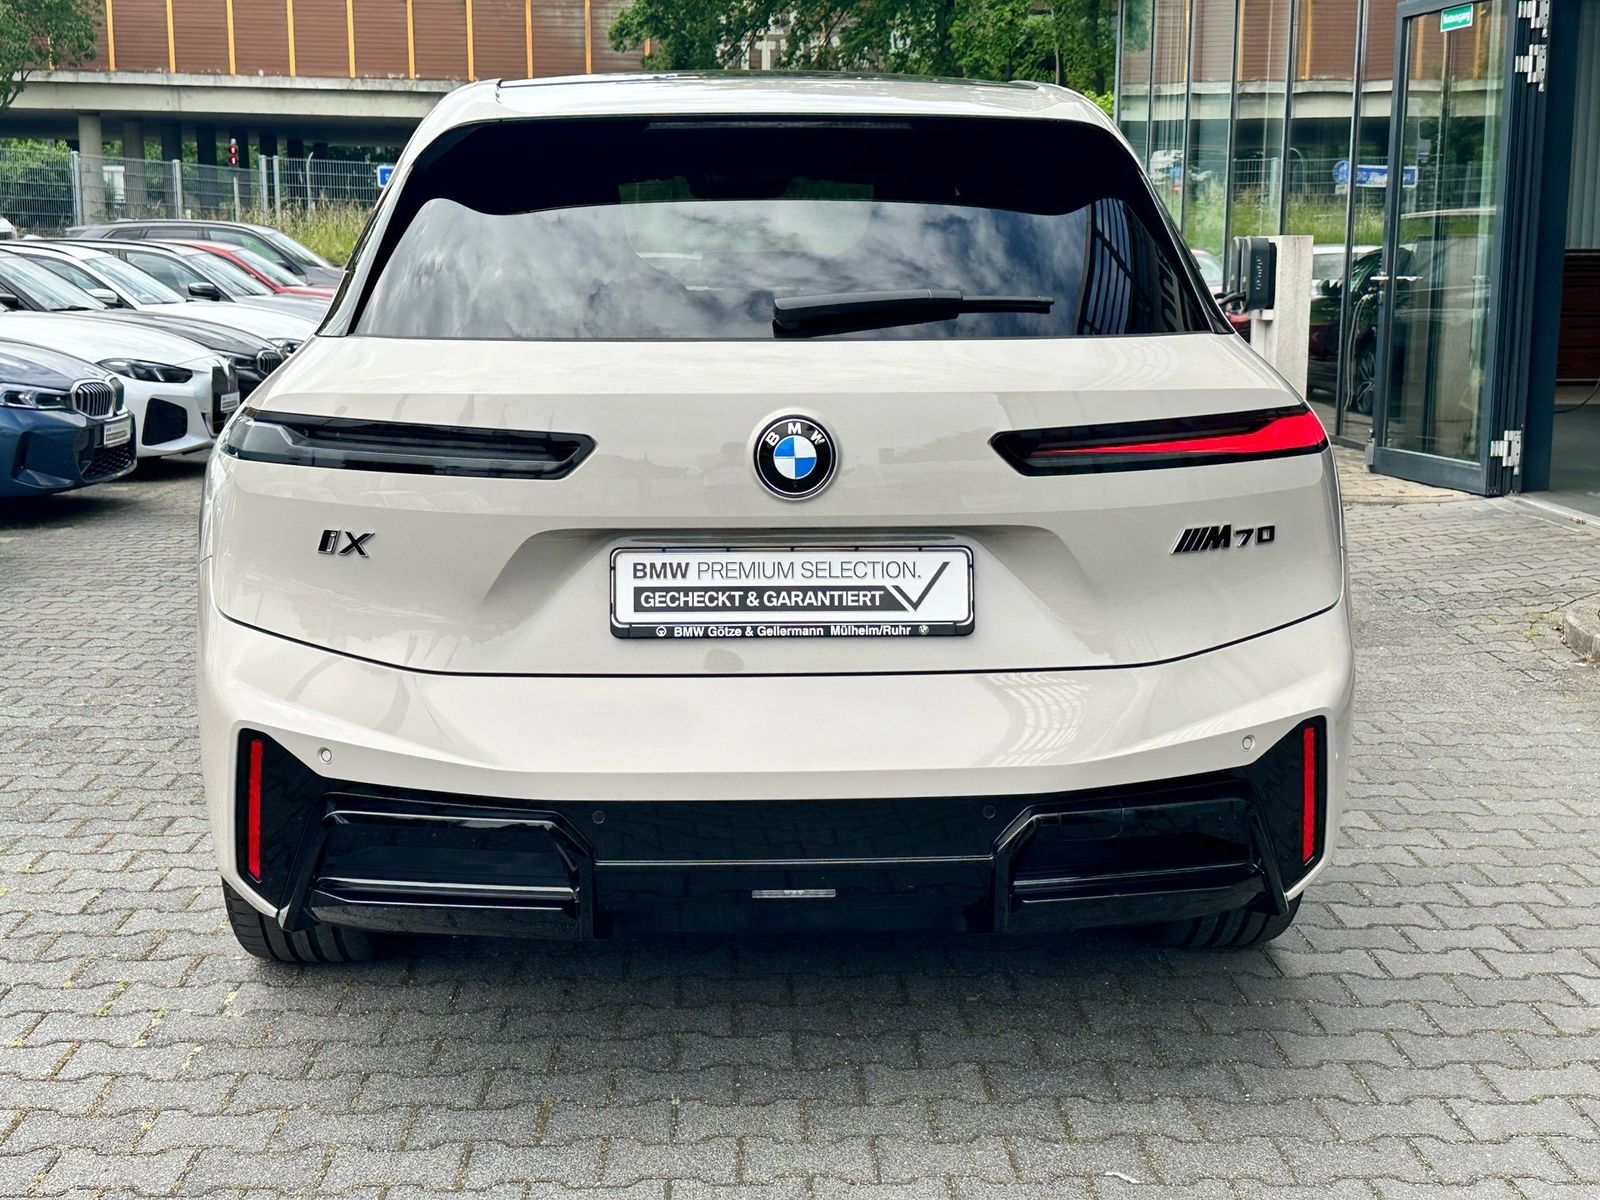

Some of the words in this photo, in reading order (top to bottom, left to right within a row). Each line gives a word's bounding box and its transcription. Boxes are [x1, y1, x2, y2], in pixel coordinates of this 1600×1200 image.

[764, 422, 826, 447] BMW
[632, 562, 690, 579] BMW
[697, 561, 795, 579] PREMIUM
[801, 561, 922, 579] SELECTION.
[640, 591, 743, 608] GECHECKT
[746, 591, 760, 607] &
[763, 590, 884, 607] GARANTIERT
[674, 627, 704, 637] BMW
[707, 626, 742, 637] Götze
[745, 626, 754, 637] &
[830, 624, 911, 636] Mülheim/Ruhr
